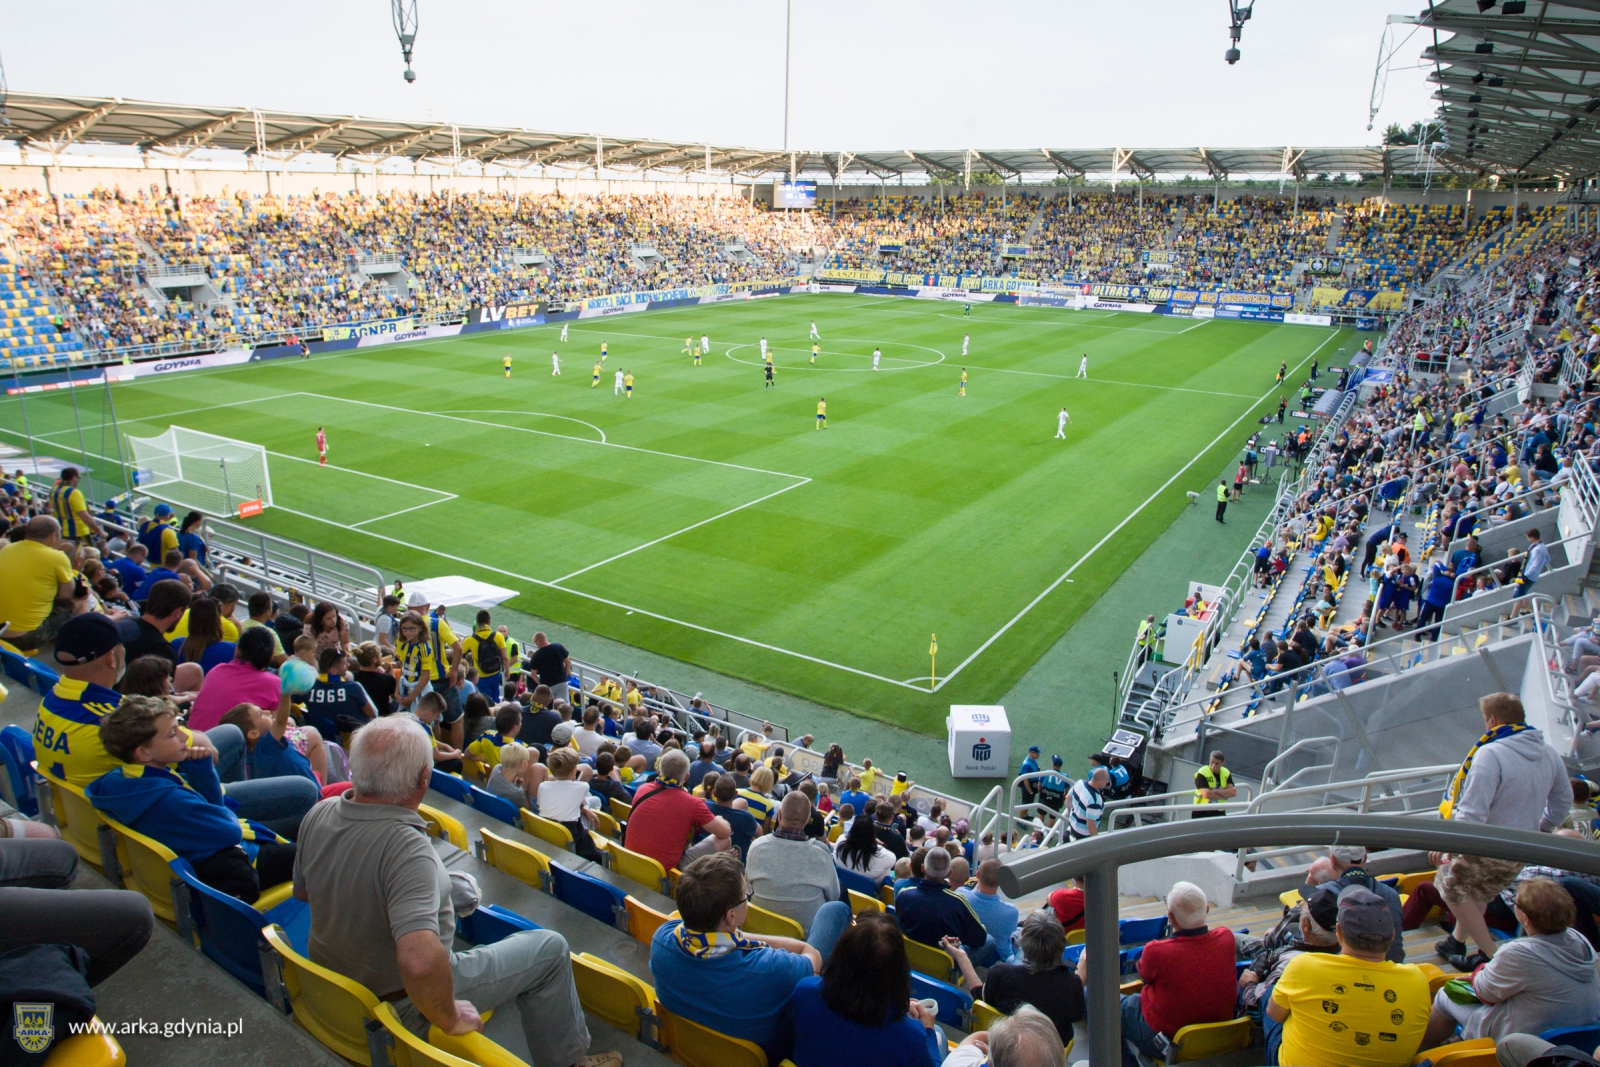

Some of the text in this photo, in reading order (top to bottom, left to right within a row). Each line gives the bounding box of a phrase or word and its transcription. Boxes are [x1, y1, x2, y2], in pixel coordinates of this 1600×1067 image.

[886, 272, 980, 290] HOOLIGANS FROM ARKA
[983, 279, 1036, 292] ARKA GDYNIA
[1093, 284, 1168, 300] ULTRAS RKA
[1200, 292, 1218, 303] NIE
[602, 306, 625, 315] GDYNIA
[394, 330, 427, 341] GDYNIA
[154, 358, 201, 372] GDYNIA
[309, 688, 347, 703] 1969
